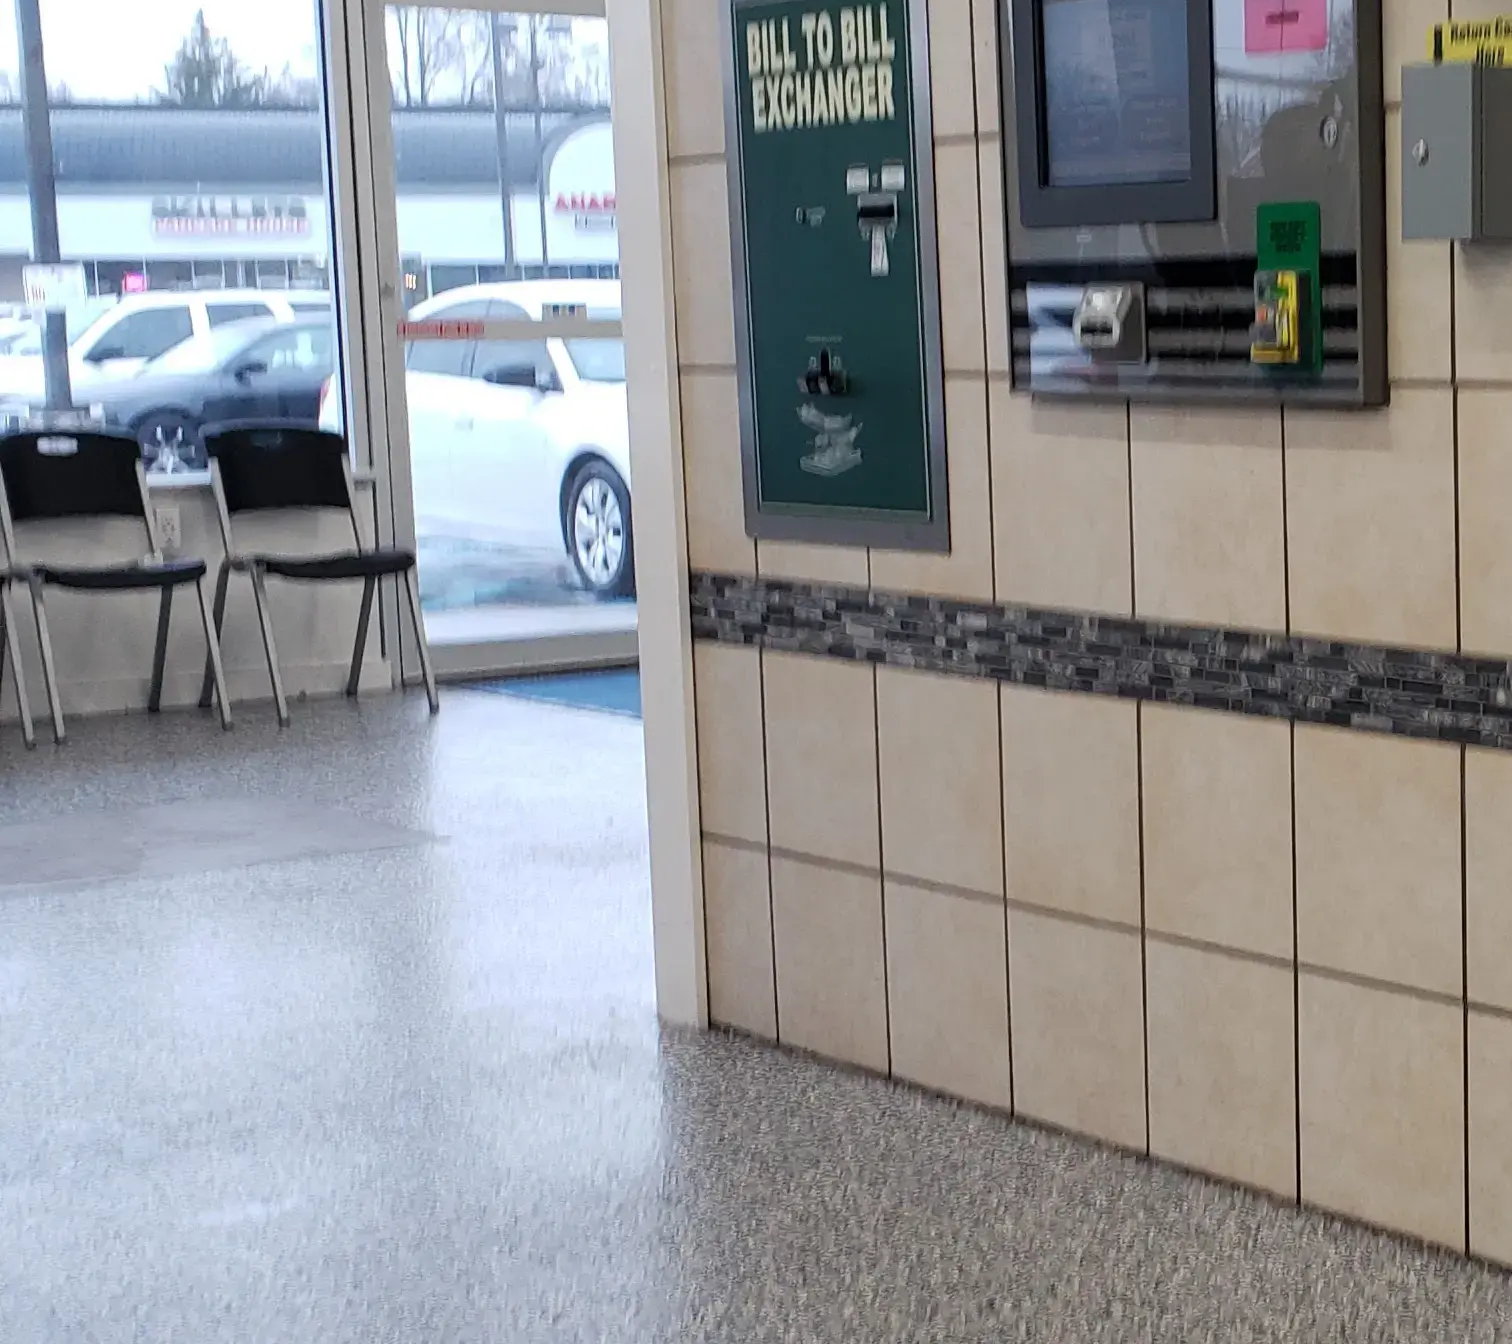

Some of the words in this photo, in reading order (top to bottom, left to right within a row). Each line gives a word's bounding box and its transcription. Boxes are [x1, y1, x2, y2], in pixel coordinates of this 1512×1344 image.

[747, 16, 797, 78] BILL
[801, 10, 833, 70] TO
[840, 1, 895, 66] BILL
[752, 60, 895, 133] EXCHANGER
